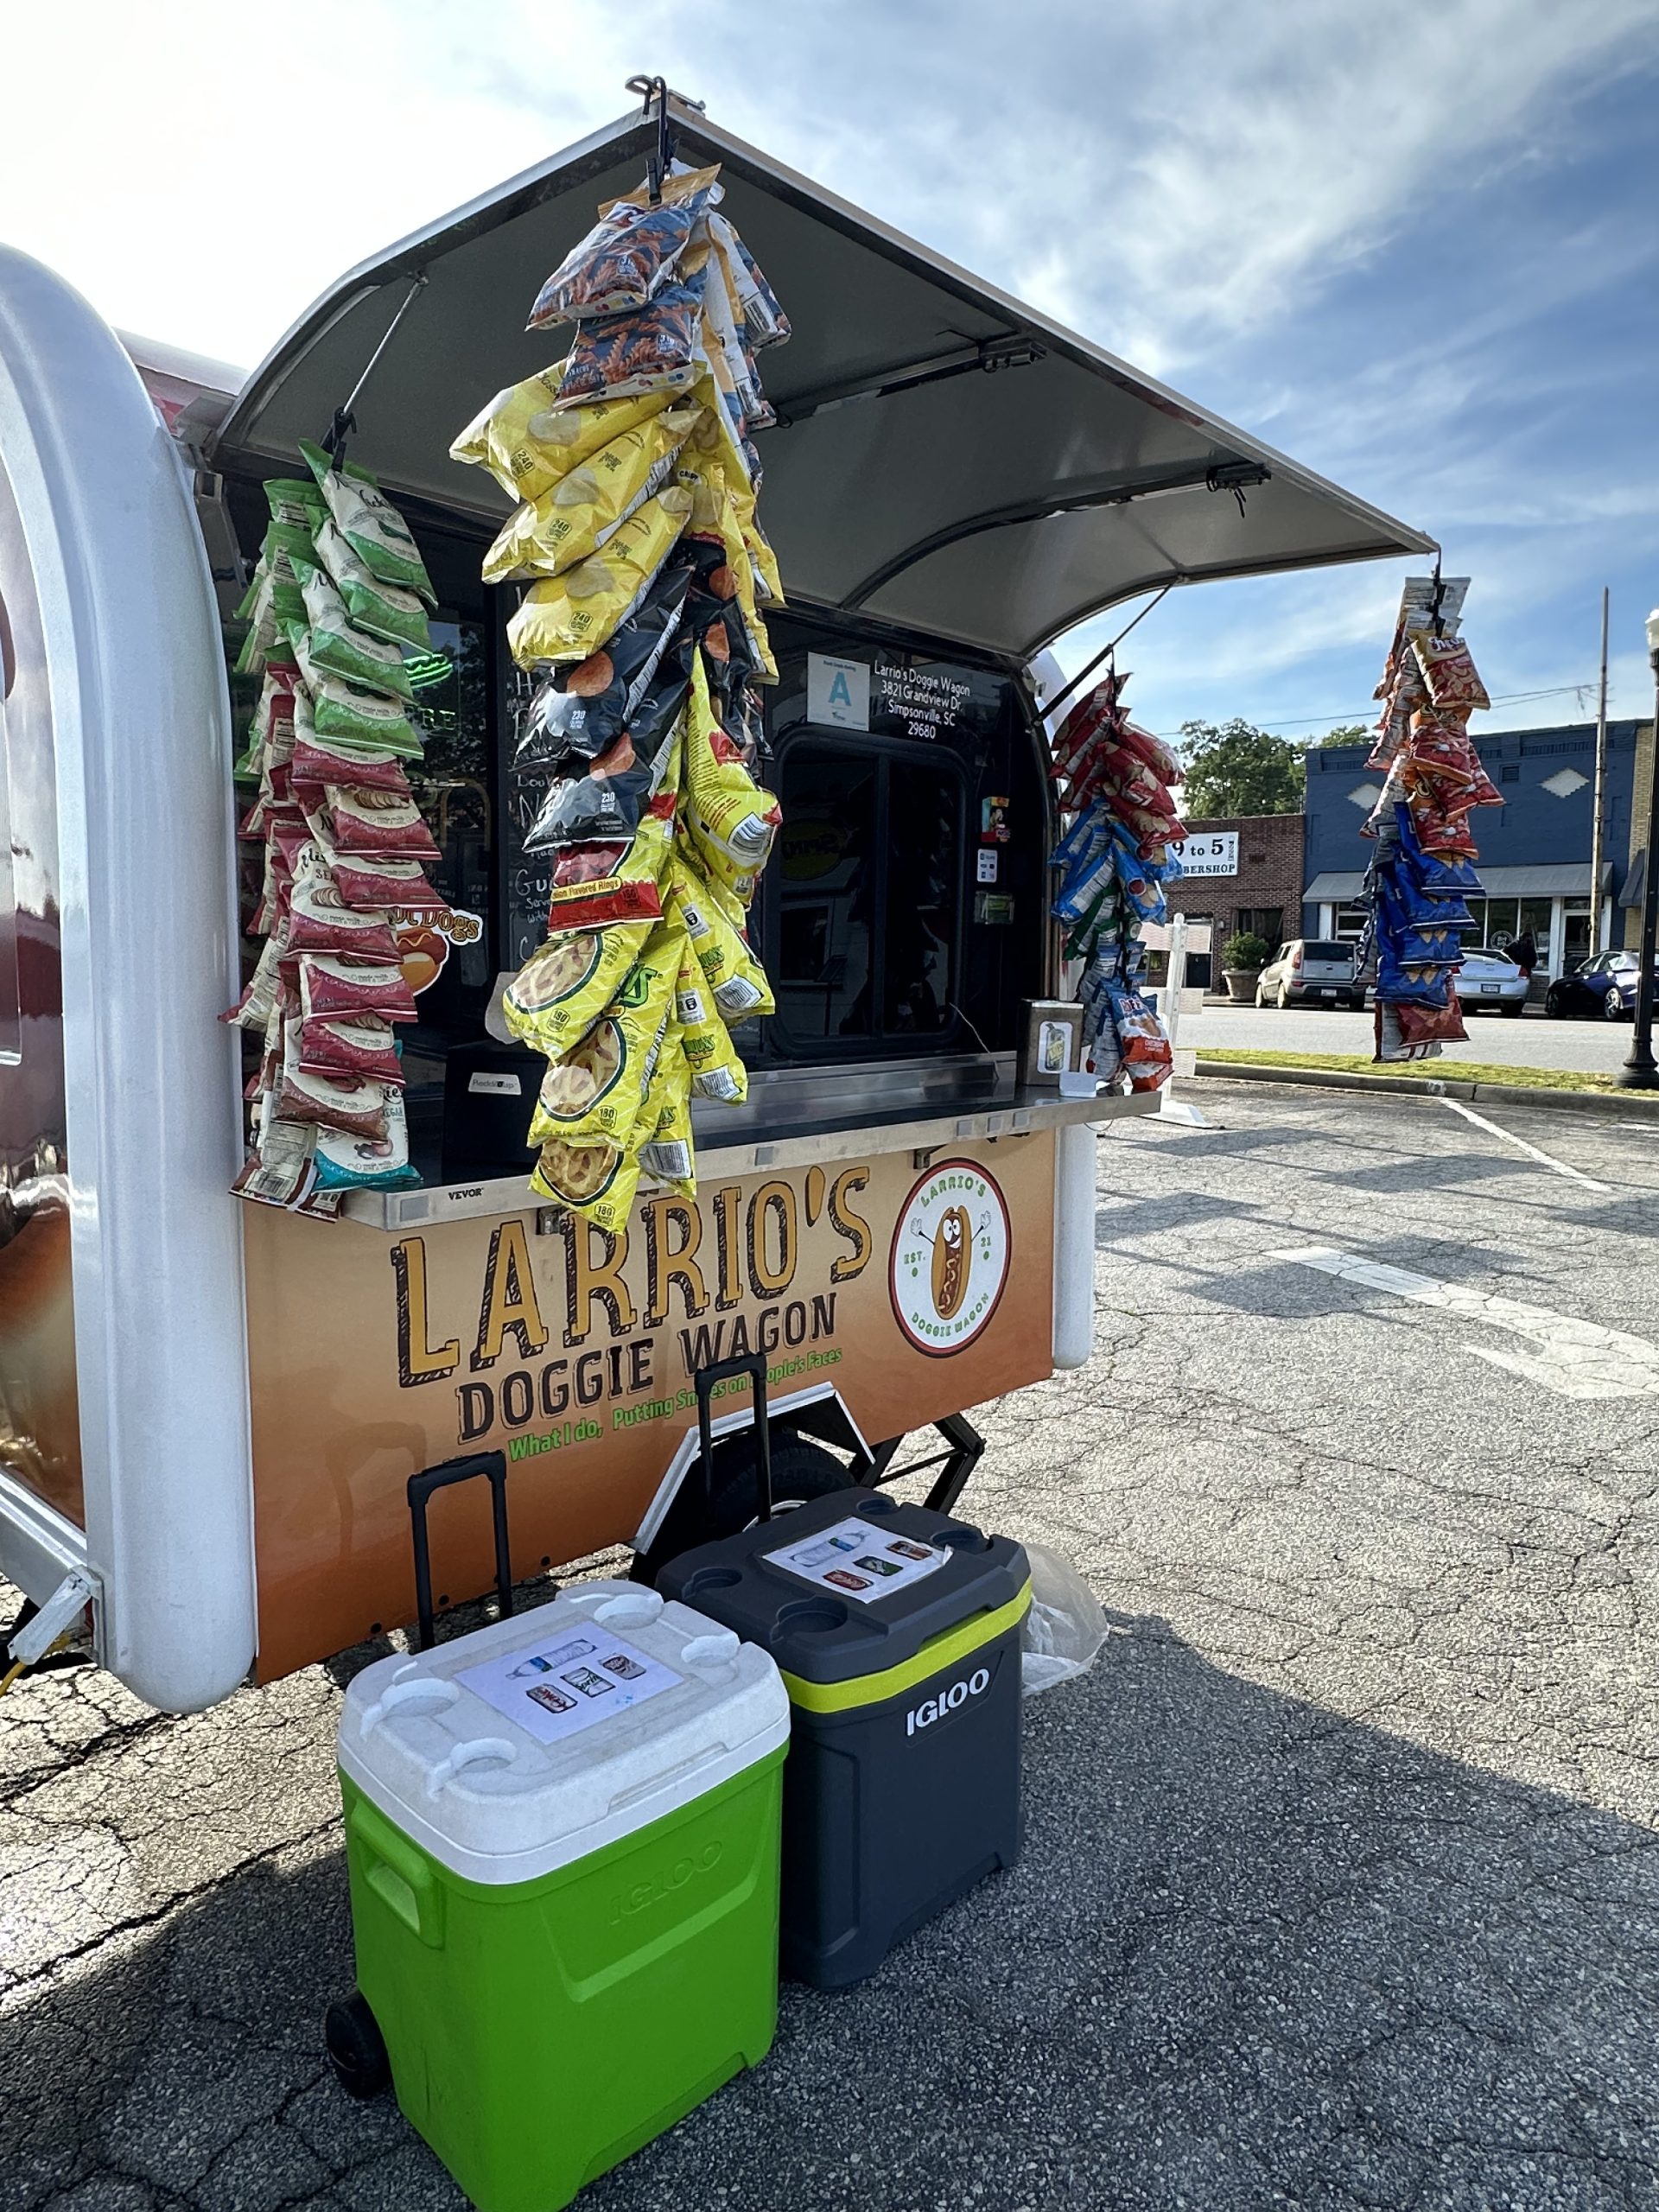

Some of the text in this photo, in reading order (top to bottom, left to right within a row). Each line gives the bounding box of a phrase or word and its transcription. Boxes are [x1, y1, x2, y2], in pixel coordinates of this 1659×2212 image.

[518, 450, 534, 470] 240
[552, 518, 569, 532] 240
[573, 612, 591, 623] 240
[828, 671, 852, 707] A
[874, 659, 908, 682] Larrio's
[908, 668, 939, 690] Doggie
[940, 676, 970, 697] Wagon
[881, 679, 902, 697] 3821
[903, 684, 950, 709] Grandview
[887, 698, 956, 727] Simpsonville, SC
[907, 721, 937, 740] 29680
[601, 791, 615, 803] 230
[1172, 838, 1224, 856] 9 to 5
[1182, 864, 1236, 874] BERSHOP
[599, 1107, 614, 1118] 180
[448, 1187, 483, 1200] VEVOR
[920, 1175, 987, 1208] LARRIO'S
[598, 1205, 612, 1217] 180
[904, 1251, 925, 1265] EST.
[391, 1166, 873, 1388] LARRIO'S
[912, 1293, 989, 1338] DOGGIE WAGON
[454, 1292, 837, 1446] DOGGIE WAGON
[508, 1427, 562, 1462] What
[563, 1421, 571, 1446] I
[574, 1417, 604, 1443] do,
[612, 1396, 675, 1431] Putting
[728, 1375, 748, 1395] on
[805, 1347, 843, 1372] Faces
[906, 1668, 990, 1737] IGLOO
[609, 1840, 723, 1926] IGLOO
